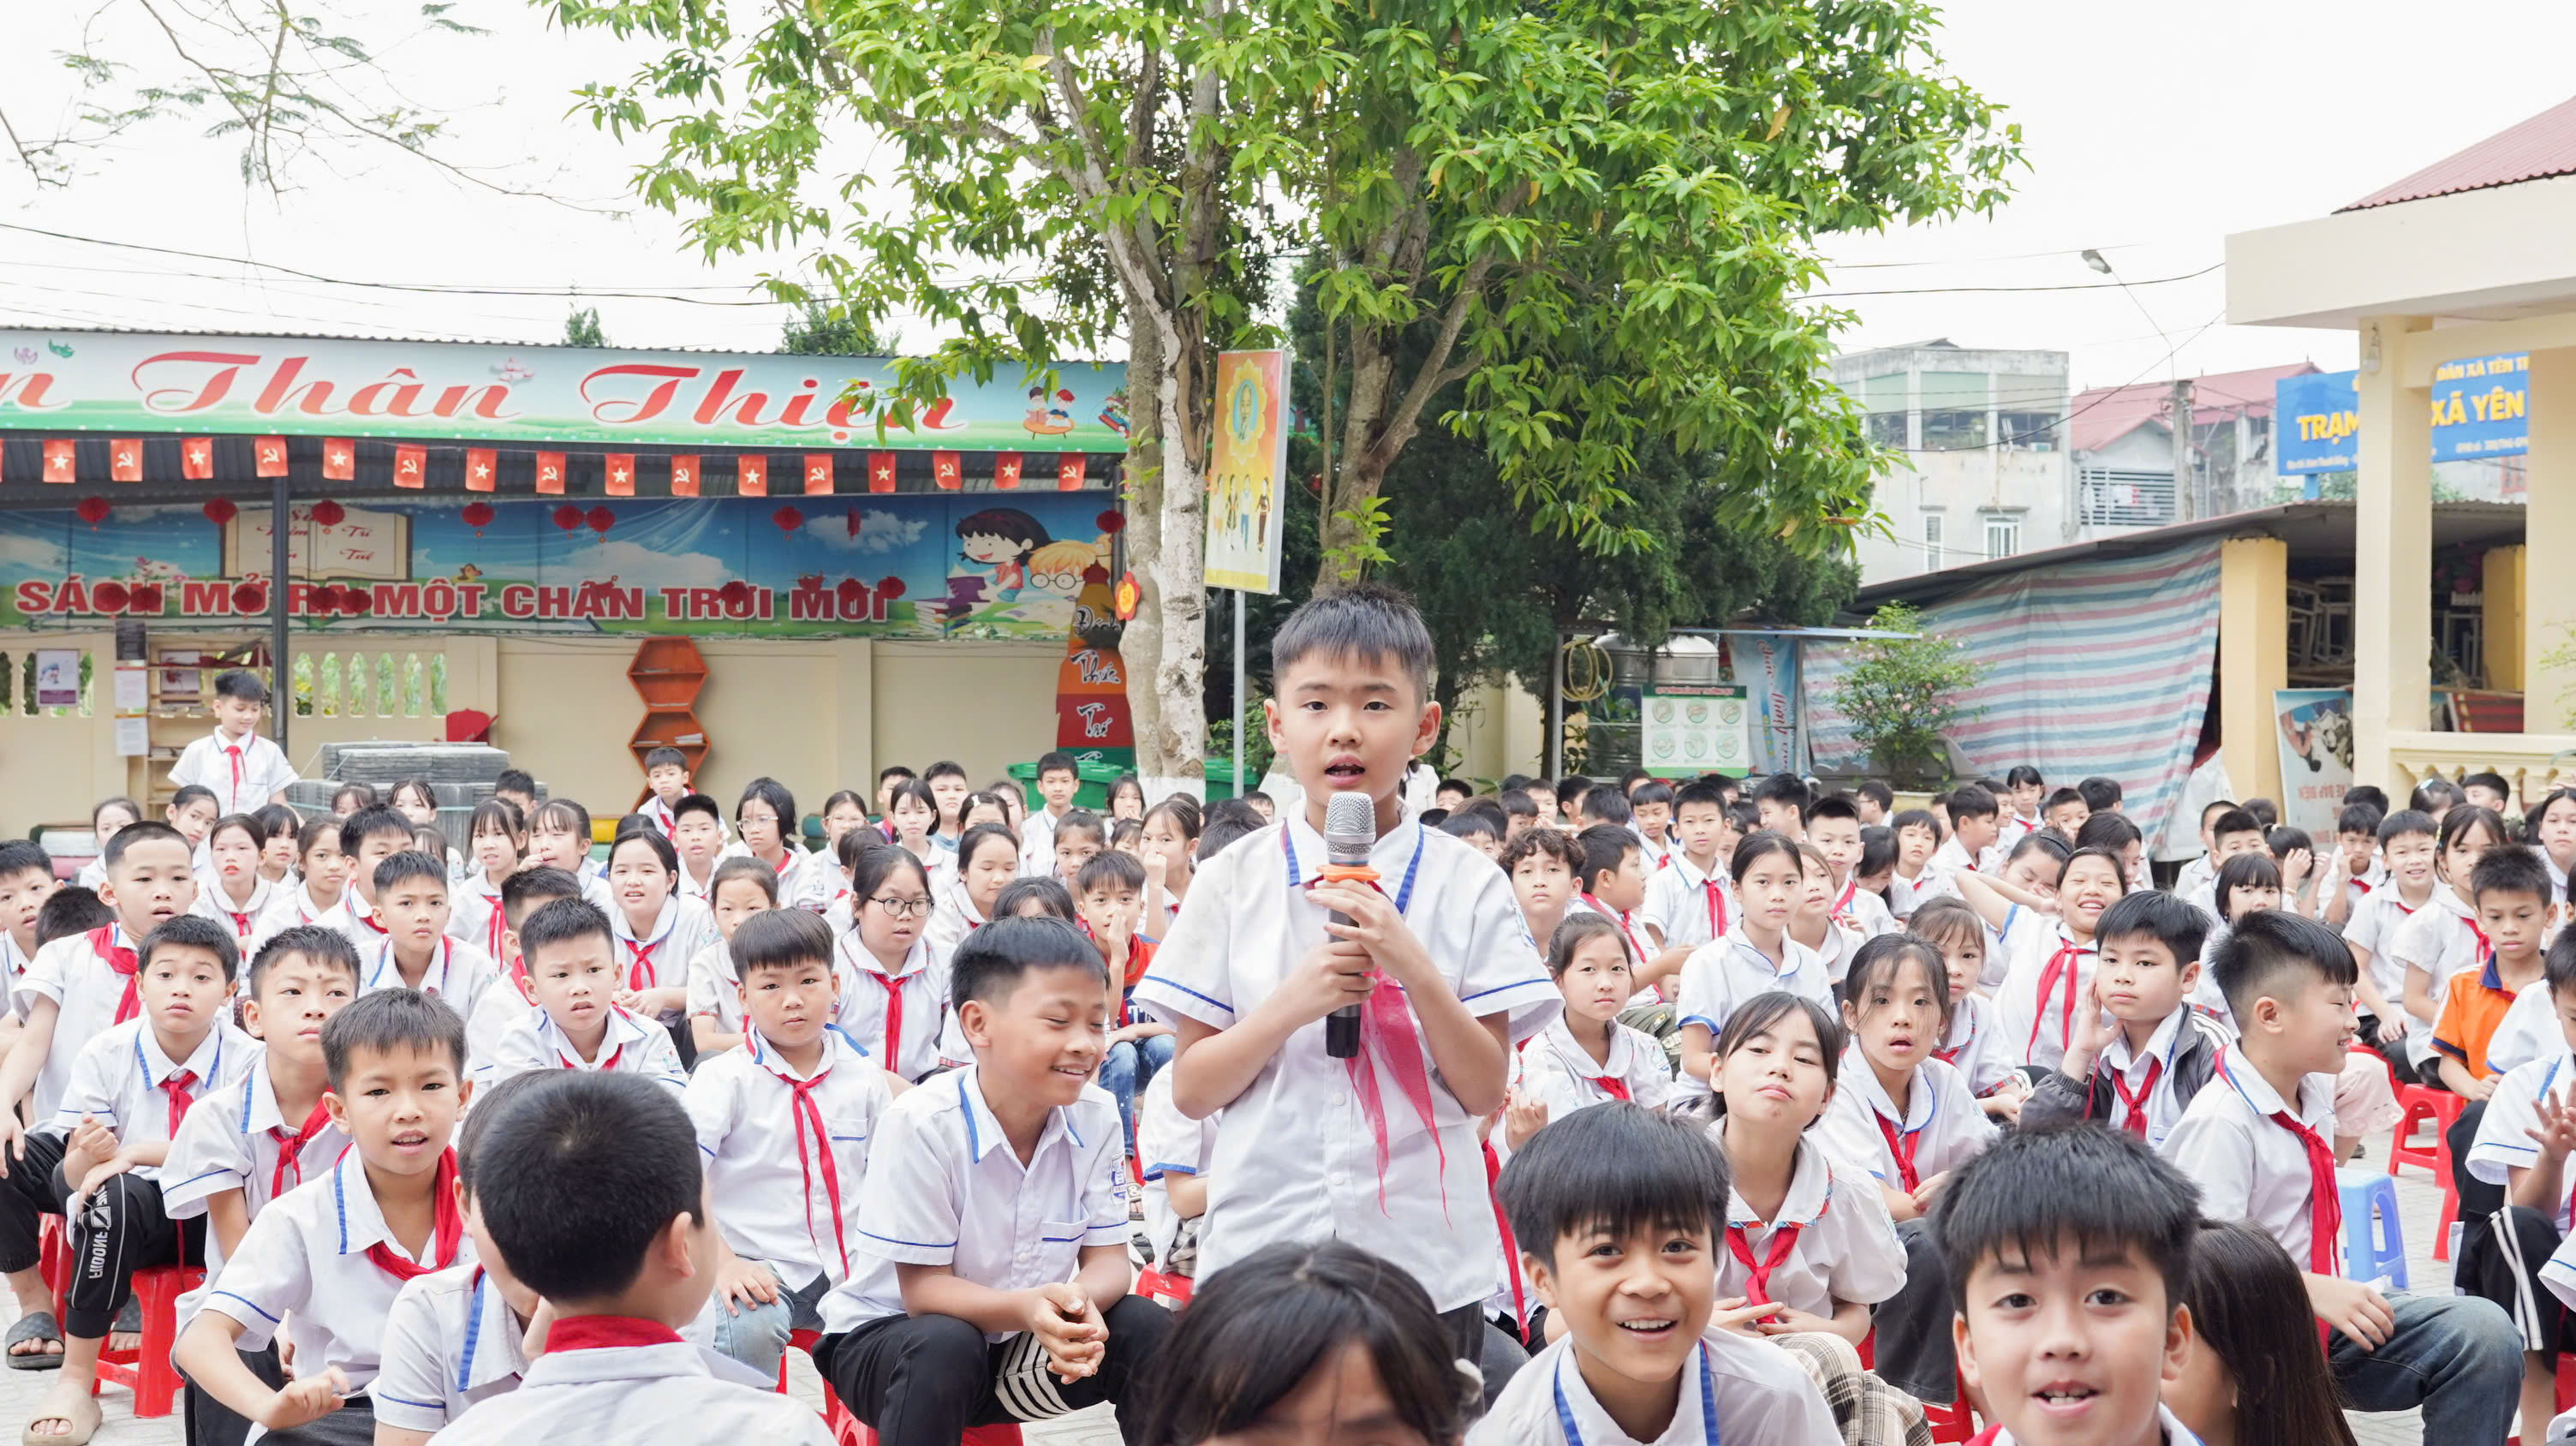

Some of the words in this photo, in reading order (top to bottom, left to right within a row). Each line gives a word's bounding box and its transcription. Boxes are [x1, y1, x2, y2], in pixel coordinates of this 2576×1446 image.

[132, 350, 521, 419] Thân
[2430, 390, 2468, 427] XÃ
[2470, 385, 2525, 421] YÊN
[183, 573, 269, 613] MỞ
[373, 578, 486, 623] MỘT
